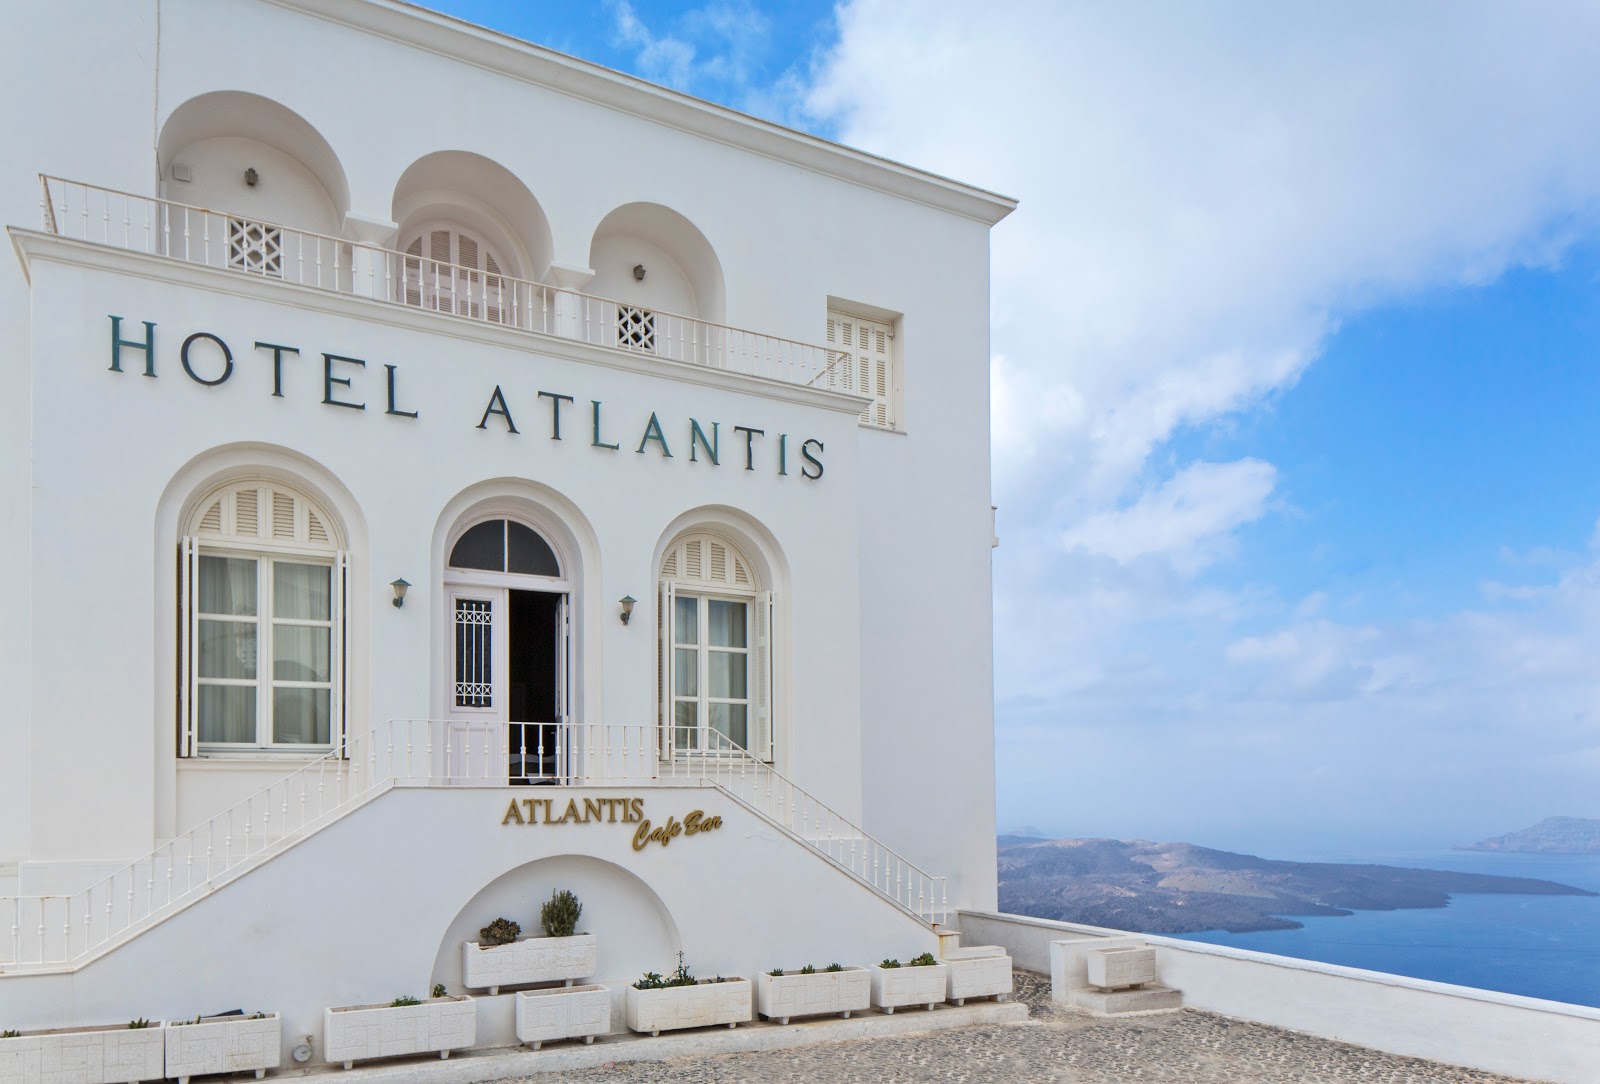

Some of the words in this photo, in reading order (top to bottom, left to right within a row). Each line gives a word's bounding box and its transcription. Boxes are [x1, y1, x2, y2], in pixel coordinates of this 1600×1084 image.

[108, 315, 418, 419] HOTEL
[476, 384, 825, 480] ATLANTIS
[502, 797, 644, 825] ATLANTIS
[632, 815, 682, 851] Cafe
[683, 810, 723, 836] Bar
